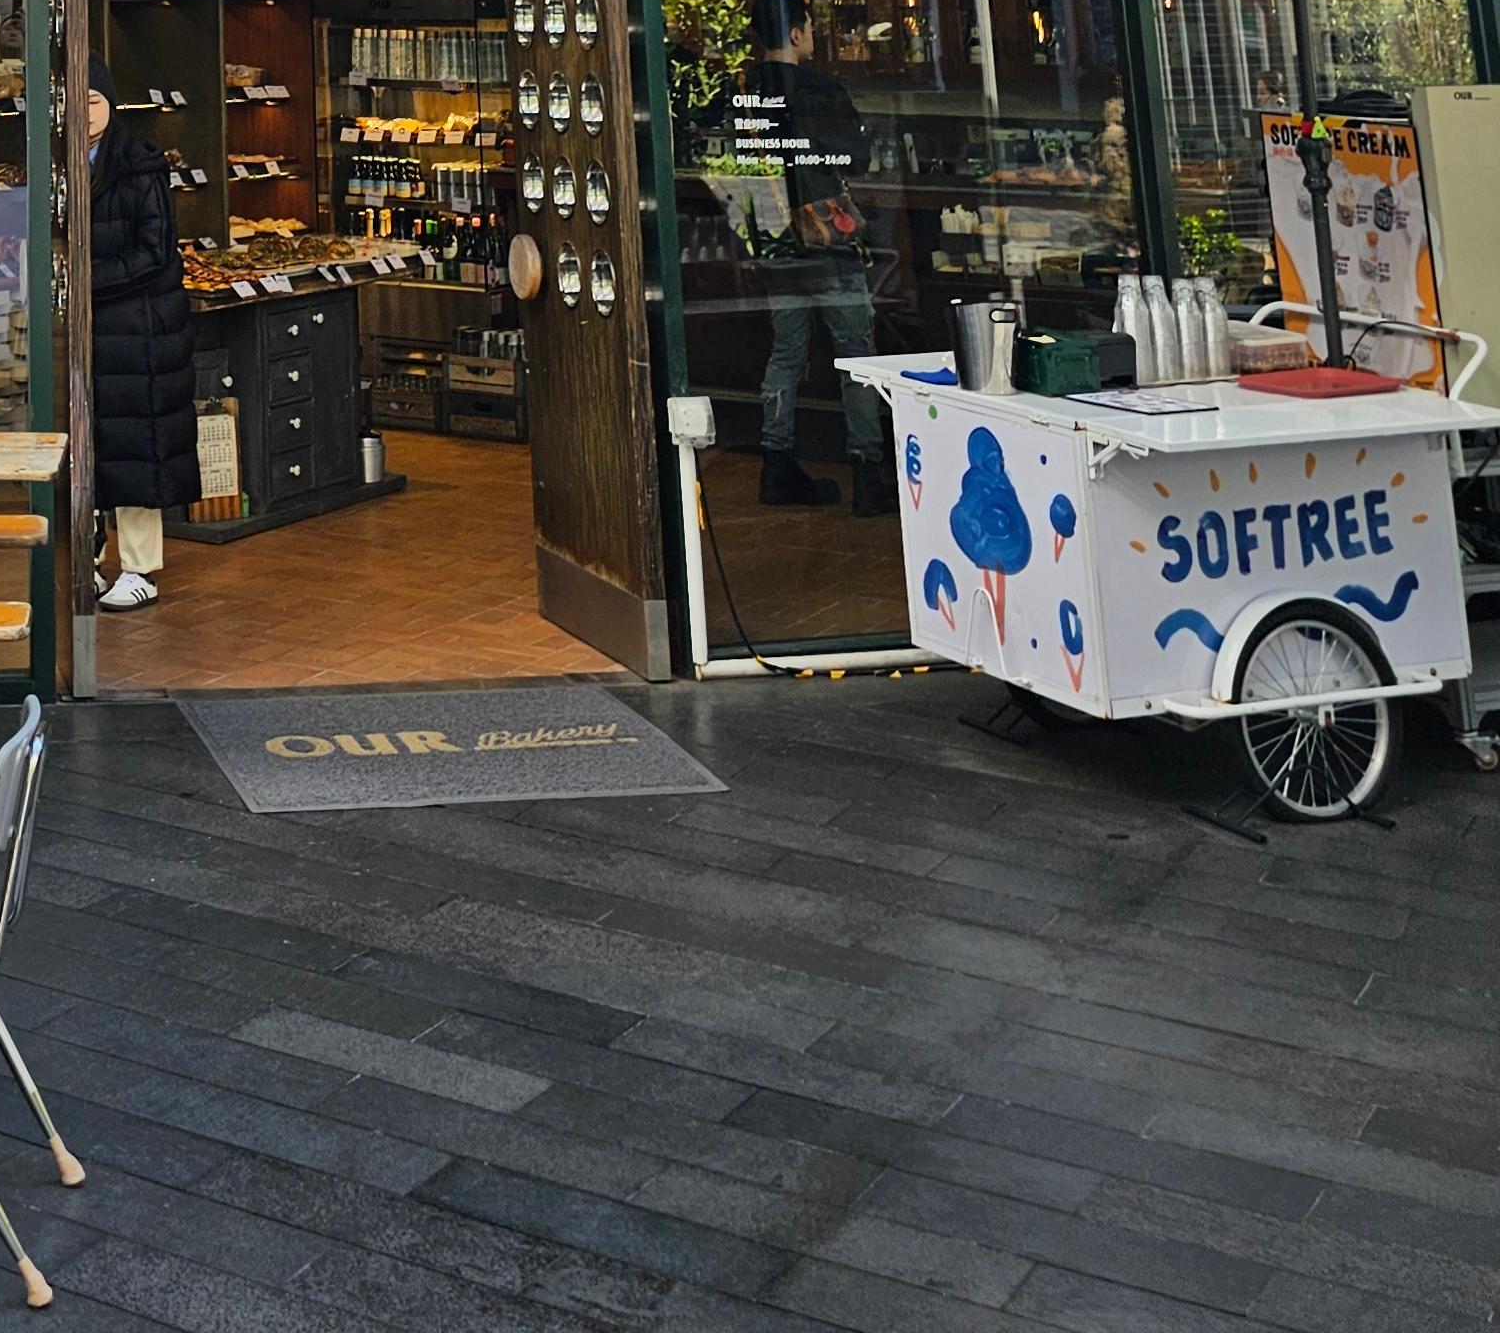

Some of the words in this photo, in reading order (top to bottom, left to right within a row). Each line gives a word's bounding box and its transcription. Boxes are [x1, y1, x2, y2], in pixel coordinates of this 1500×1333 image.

[732, 94, 761, 108] OUR
[1453, 91, 1473, 100] OUR
[735, 138, 780, 149] BUSINESS
[781, 138, 810, 149] HOUR
[1270, 123, 1302, 146] SOF
[1347, 132, 1411, 159] CREAM
[1156, 488, 1395, 584] SOFTREE
[264, 730, 466, 759] OUR
[476, 722, 620, 751] Bakery
